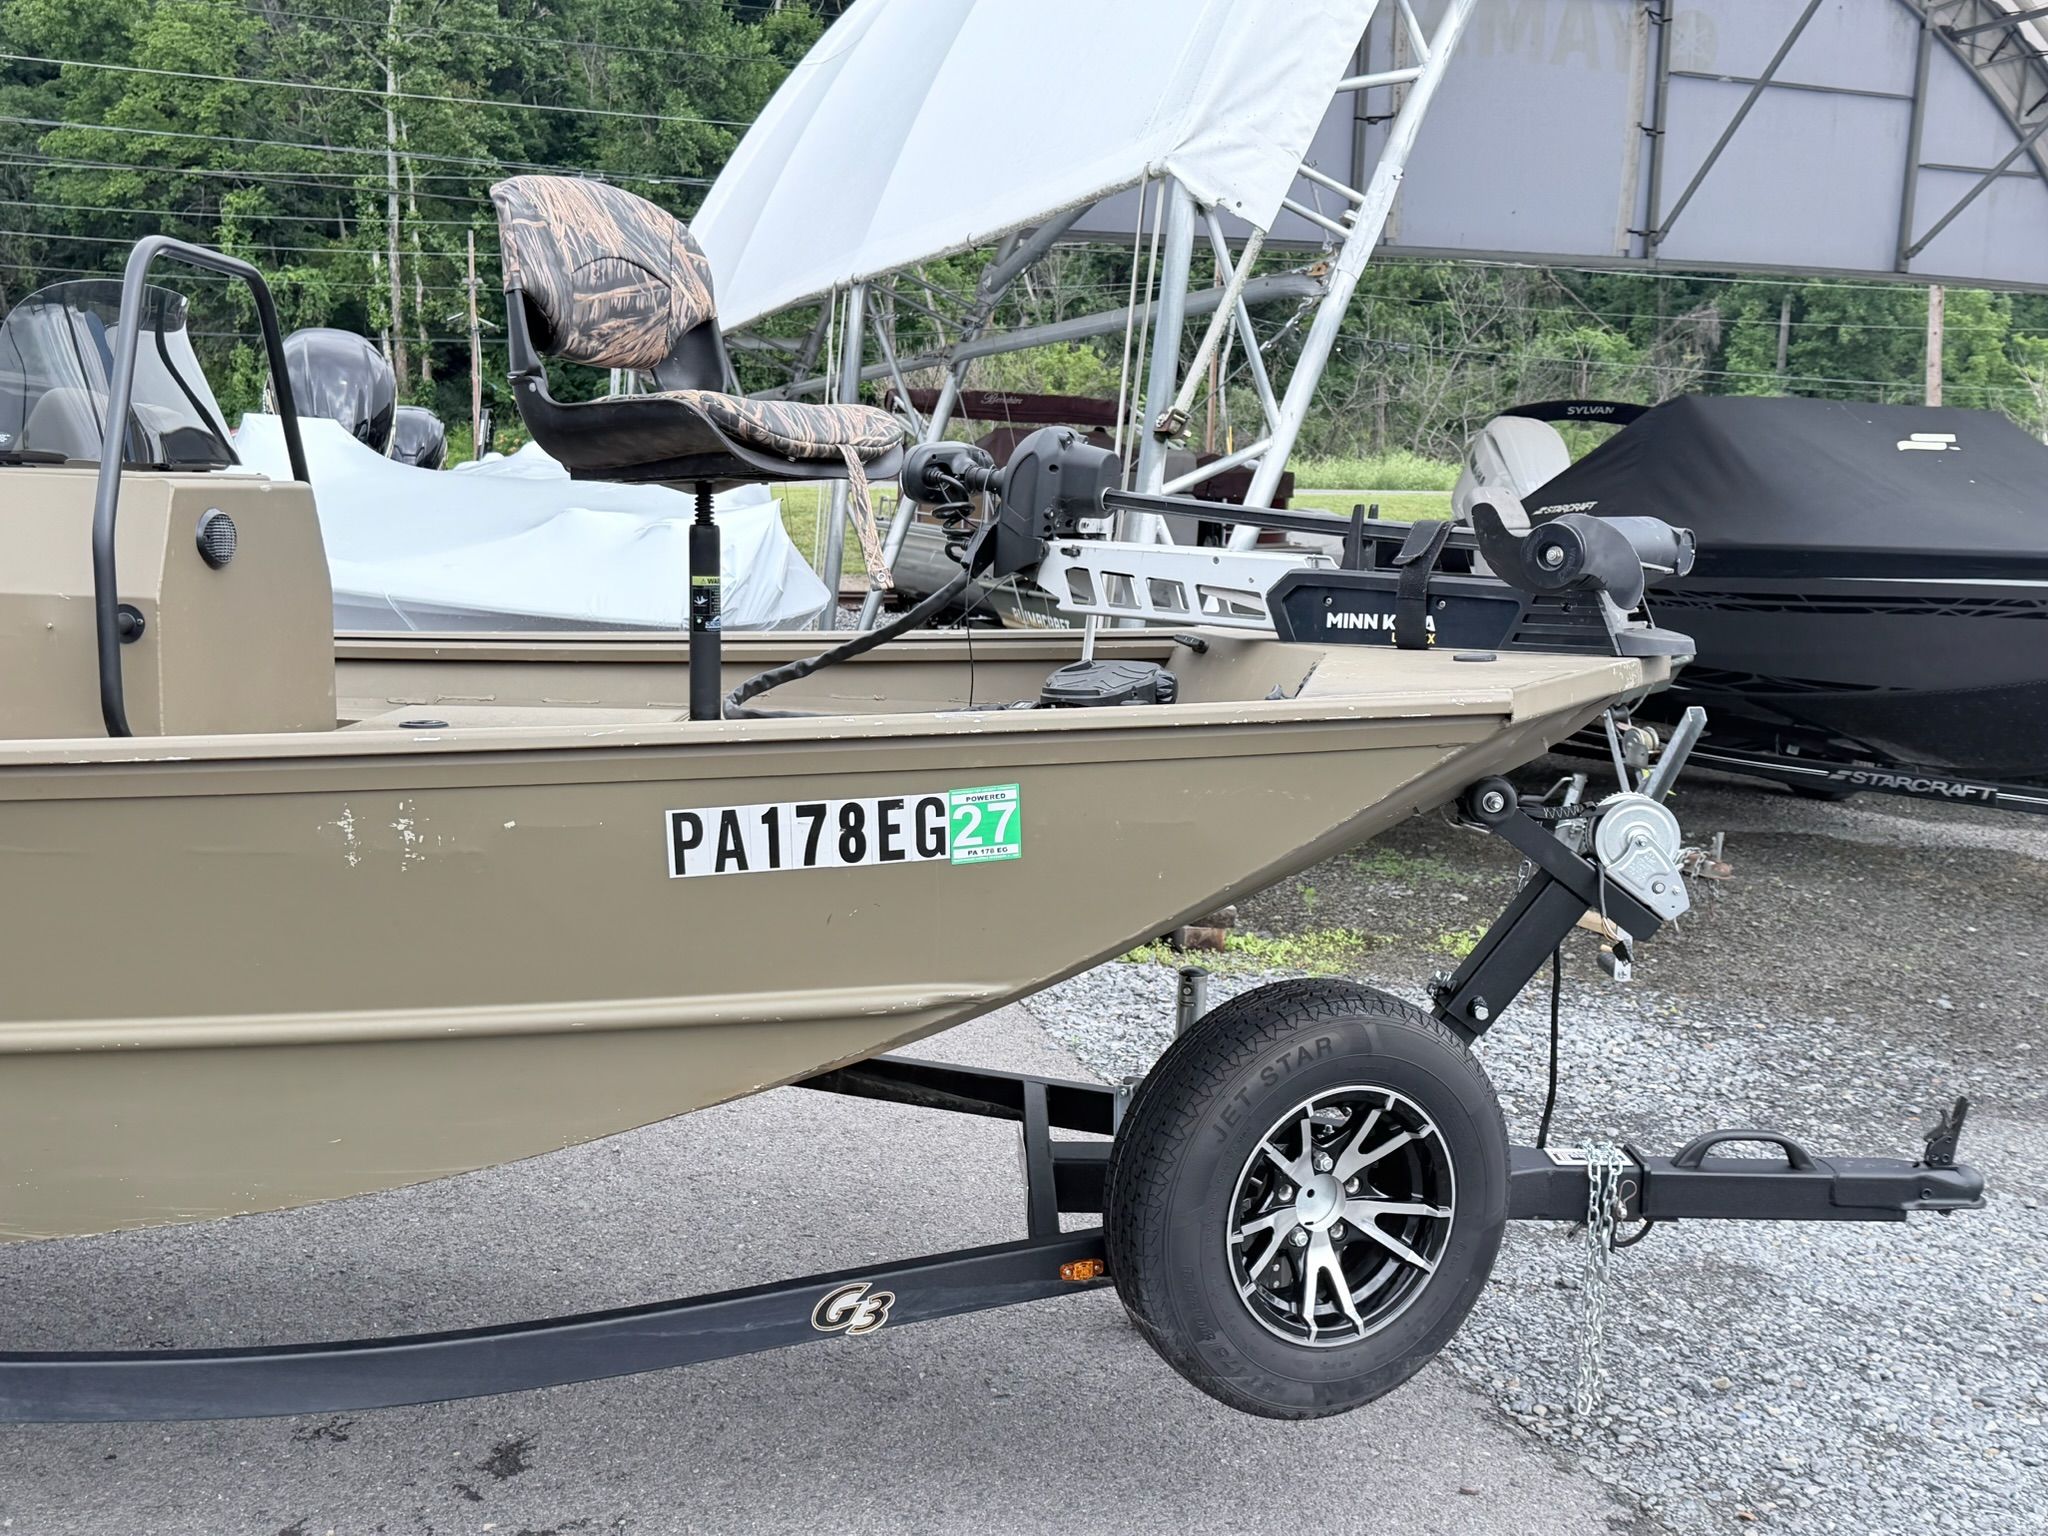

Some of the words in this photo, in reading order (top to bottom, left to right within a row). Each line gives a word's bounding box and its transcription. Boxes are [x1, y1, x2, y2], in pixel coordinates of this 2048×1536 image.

[1567, 406, 1615, 415] SYLVAN
[1542, 501, 1598, 515] STARCRAFT
[1326, 612, 1378, 630] MINN
[1382, 613, 1436, 632] KA
[965, 793, 1006, 802] POWERED
[1848, 770, 1998, 801] STARCRAFT
[952, 801, 1017, 847] 27
[1212, 1085, 1251, 1143] JET
[1260, 1036, 1333, 1087] STAR
[811, 1282, 896, 1336] G3
